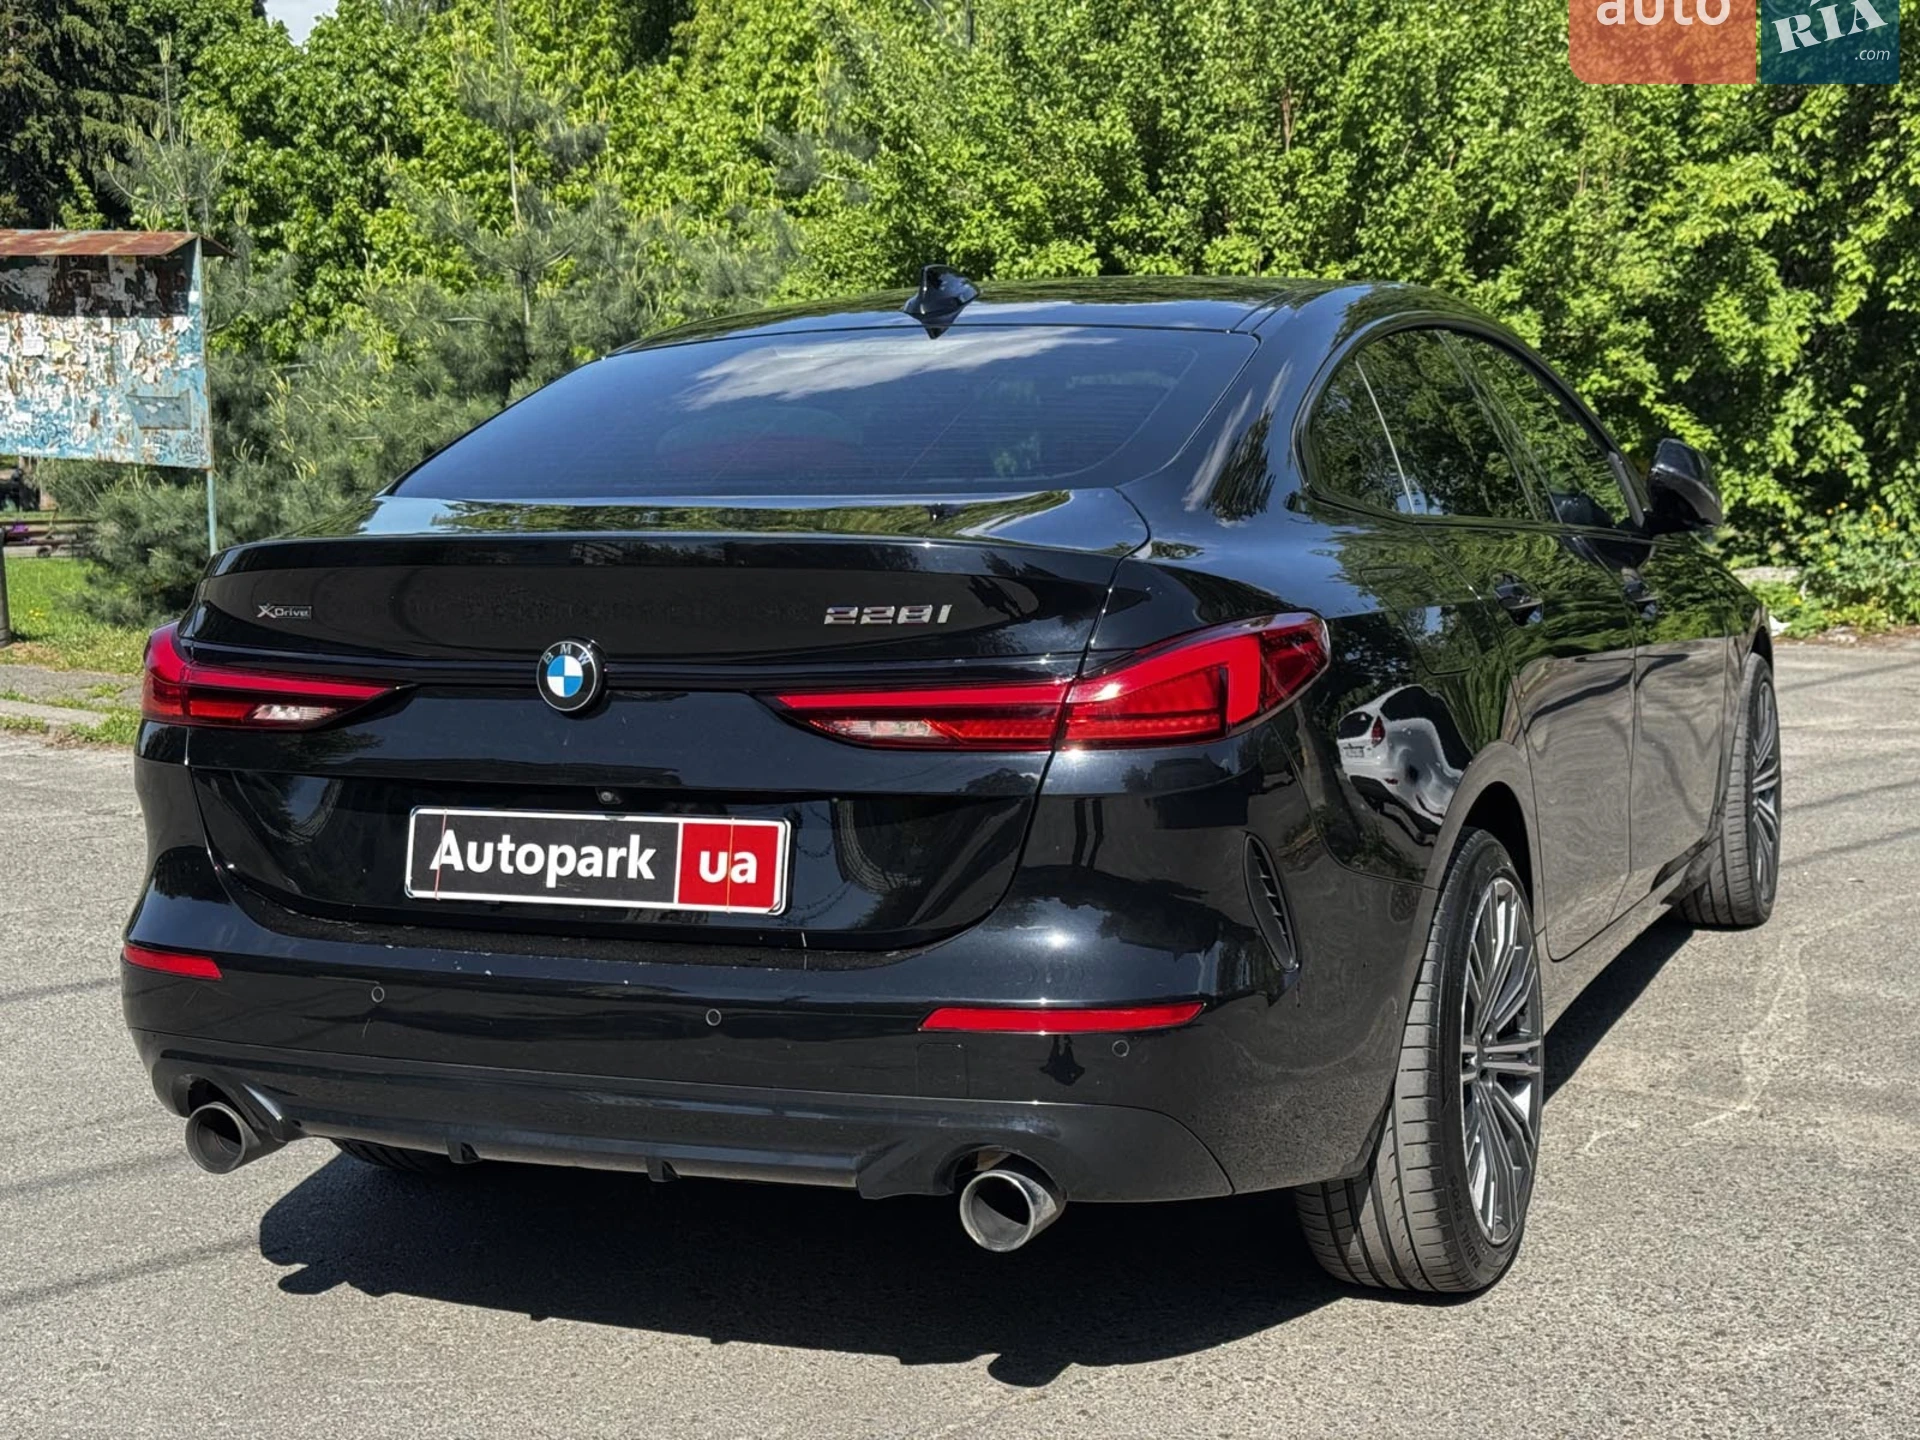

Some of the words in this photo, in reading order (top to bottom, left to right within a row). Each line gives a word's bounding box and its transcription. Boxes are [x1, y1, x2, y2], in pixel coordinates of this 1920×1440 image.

[543, 643, 591, 665] BMW
[429, 829, 657, 888] Autopark
[698, 848, 758, 884] ua
